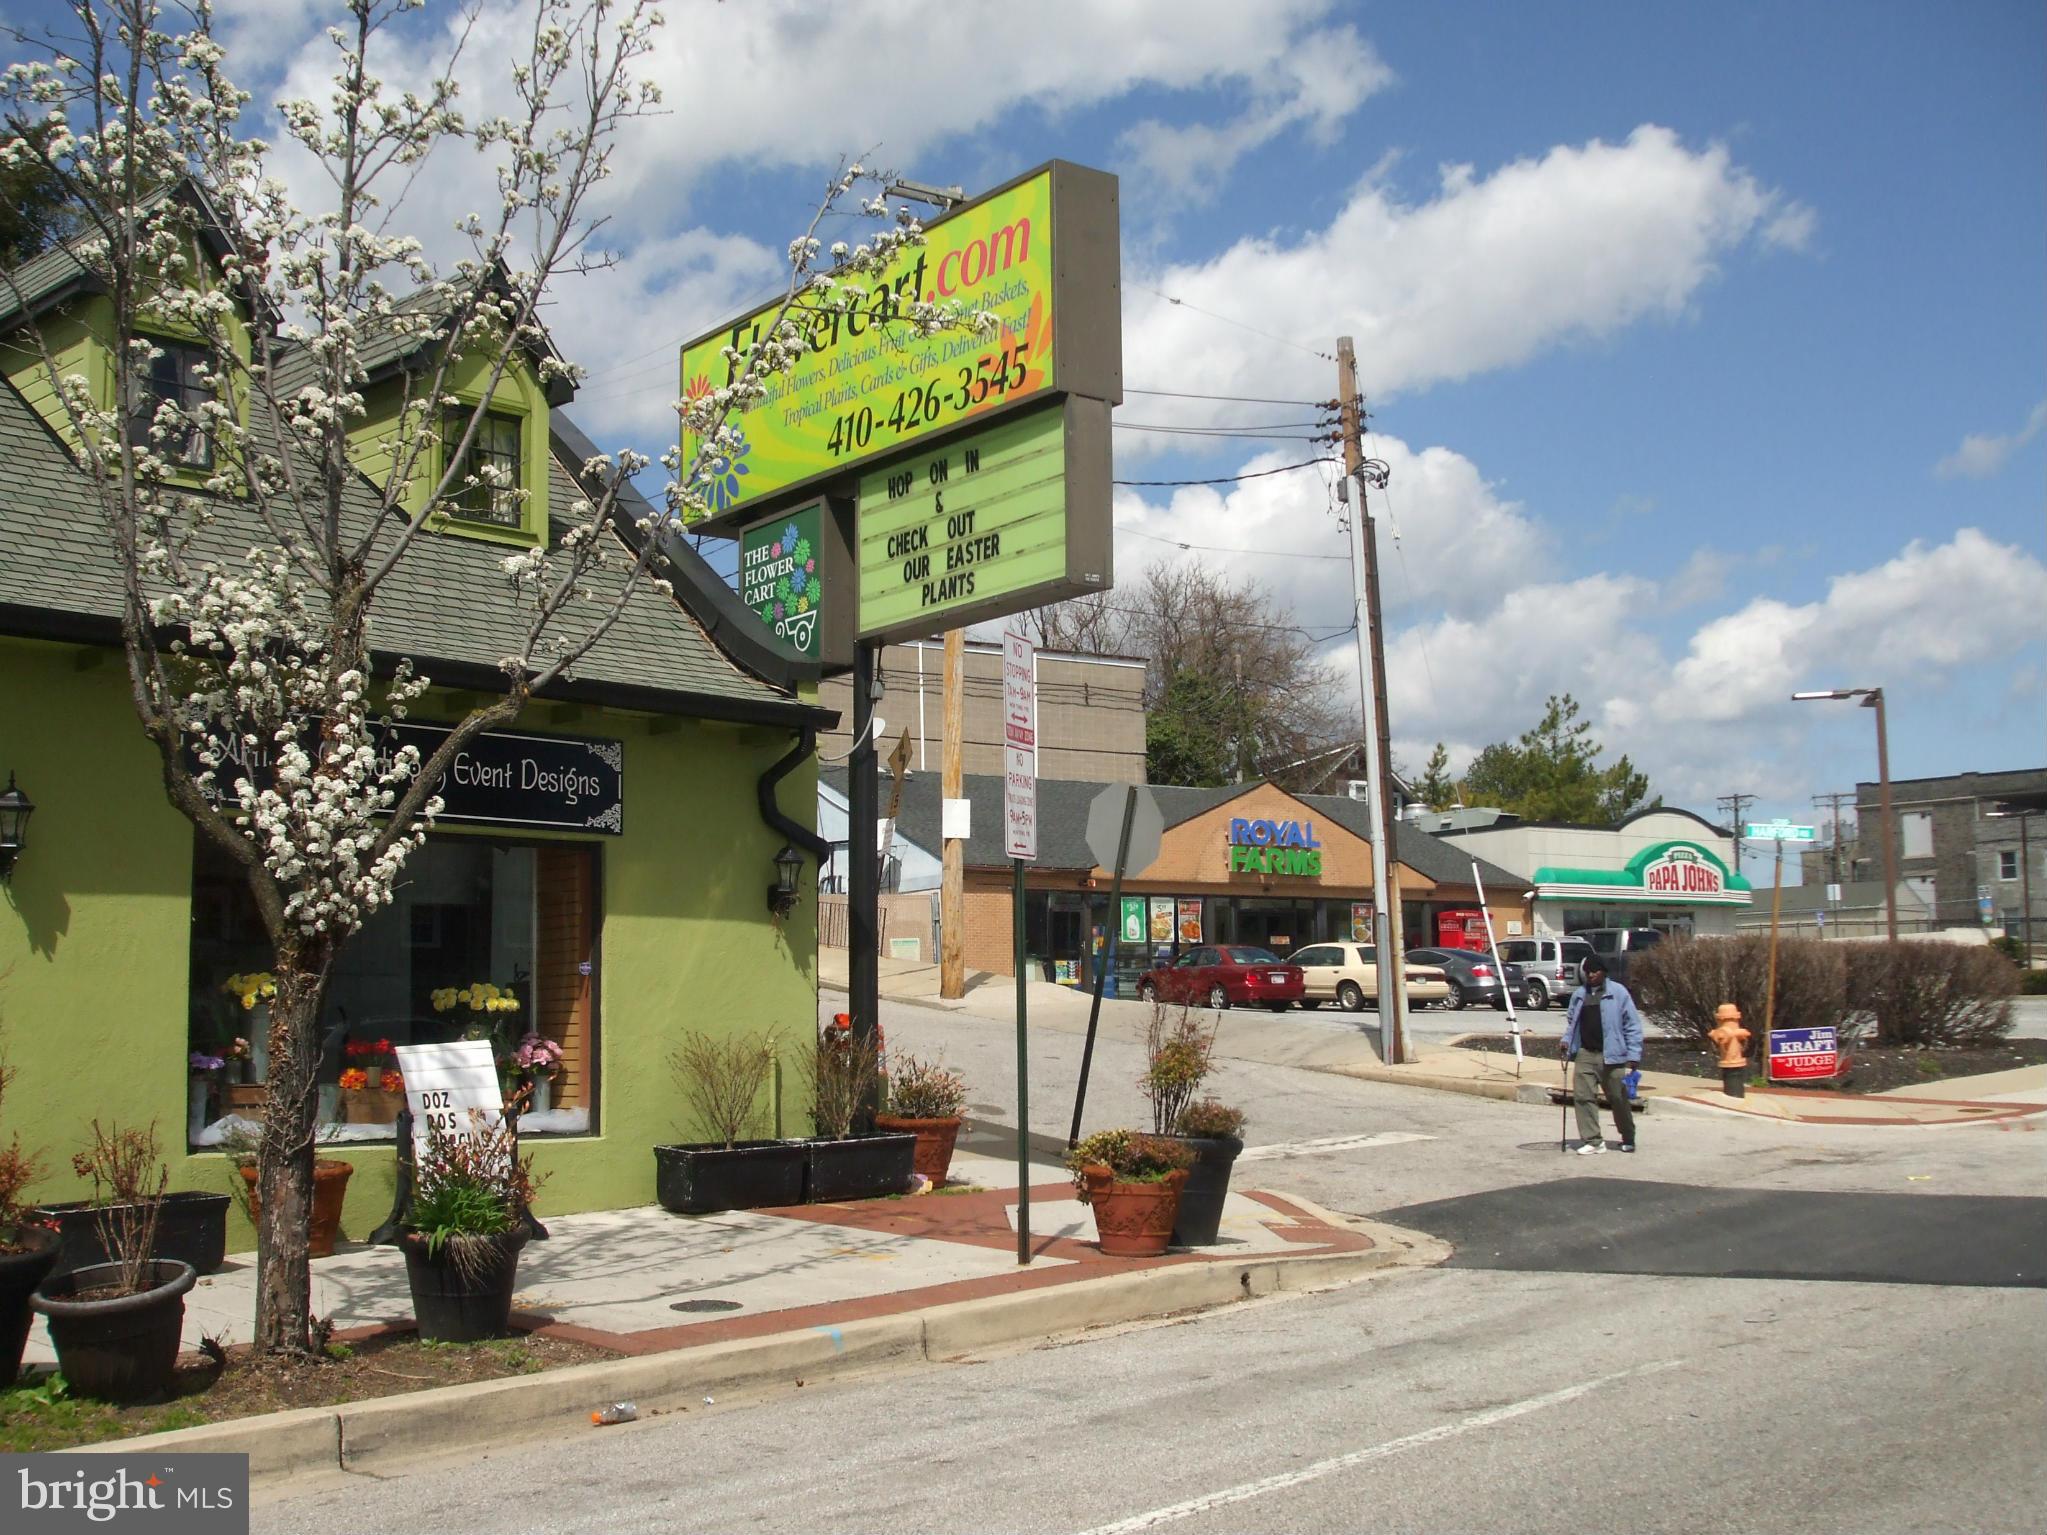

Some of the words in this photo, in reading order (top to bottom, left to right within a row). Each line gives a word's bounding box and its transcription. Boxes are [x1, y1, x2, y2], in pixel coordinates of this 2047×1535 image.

[784, 394, 822, 428] Tropical
[861, 367, 893, 395] Cards
[827, 343, 1029, 457] 410-426-3545
[888, 471, 913, 500] HOP
[930, 458, 948, 484] ON
[965, 448, 980, 473] IN
[935, 491, 944, 513] &
[887, 525, 928, 559] CHECK
[947, 509, 975, 539] OUT
[744, 544, 770, 568] THE
[903, 555, 930, 583] OUR
[946, 533, 1000, 570] EASTER
[745, 556, 795, 587] FLOWER
[744, 581, 776, 606] CART
[921, 571, 975, 607] PLANTS
[1012, 641, 1023, 658] NO
[1006, 661, 1031, 684] STOPPING
[453, 752, 513, 789] Event
[520, 758, 600, 805] Designs
[1009, 771, 1032, 790] PARKING
[1229, 817, 1321, 848] ROYAL
[1229, 845, 1322, 877] FARMS
[1649, 864, 1679, 891] PAPA
[1682, 864, 1718, 892] JOHNS
[1780, 1040, 1834, 1053] KRAFT
[1809, 1030, 1833, 1040] Jim
[1785, 1055, 1835, 1068] JUDGE
[422, 1091, 450, 1109] DOZ
